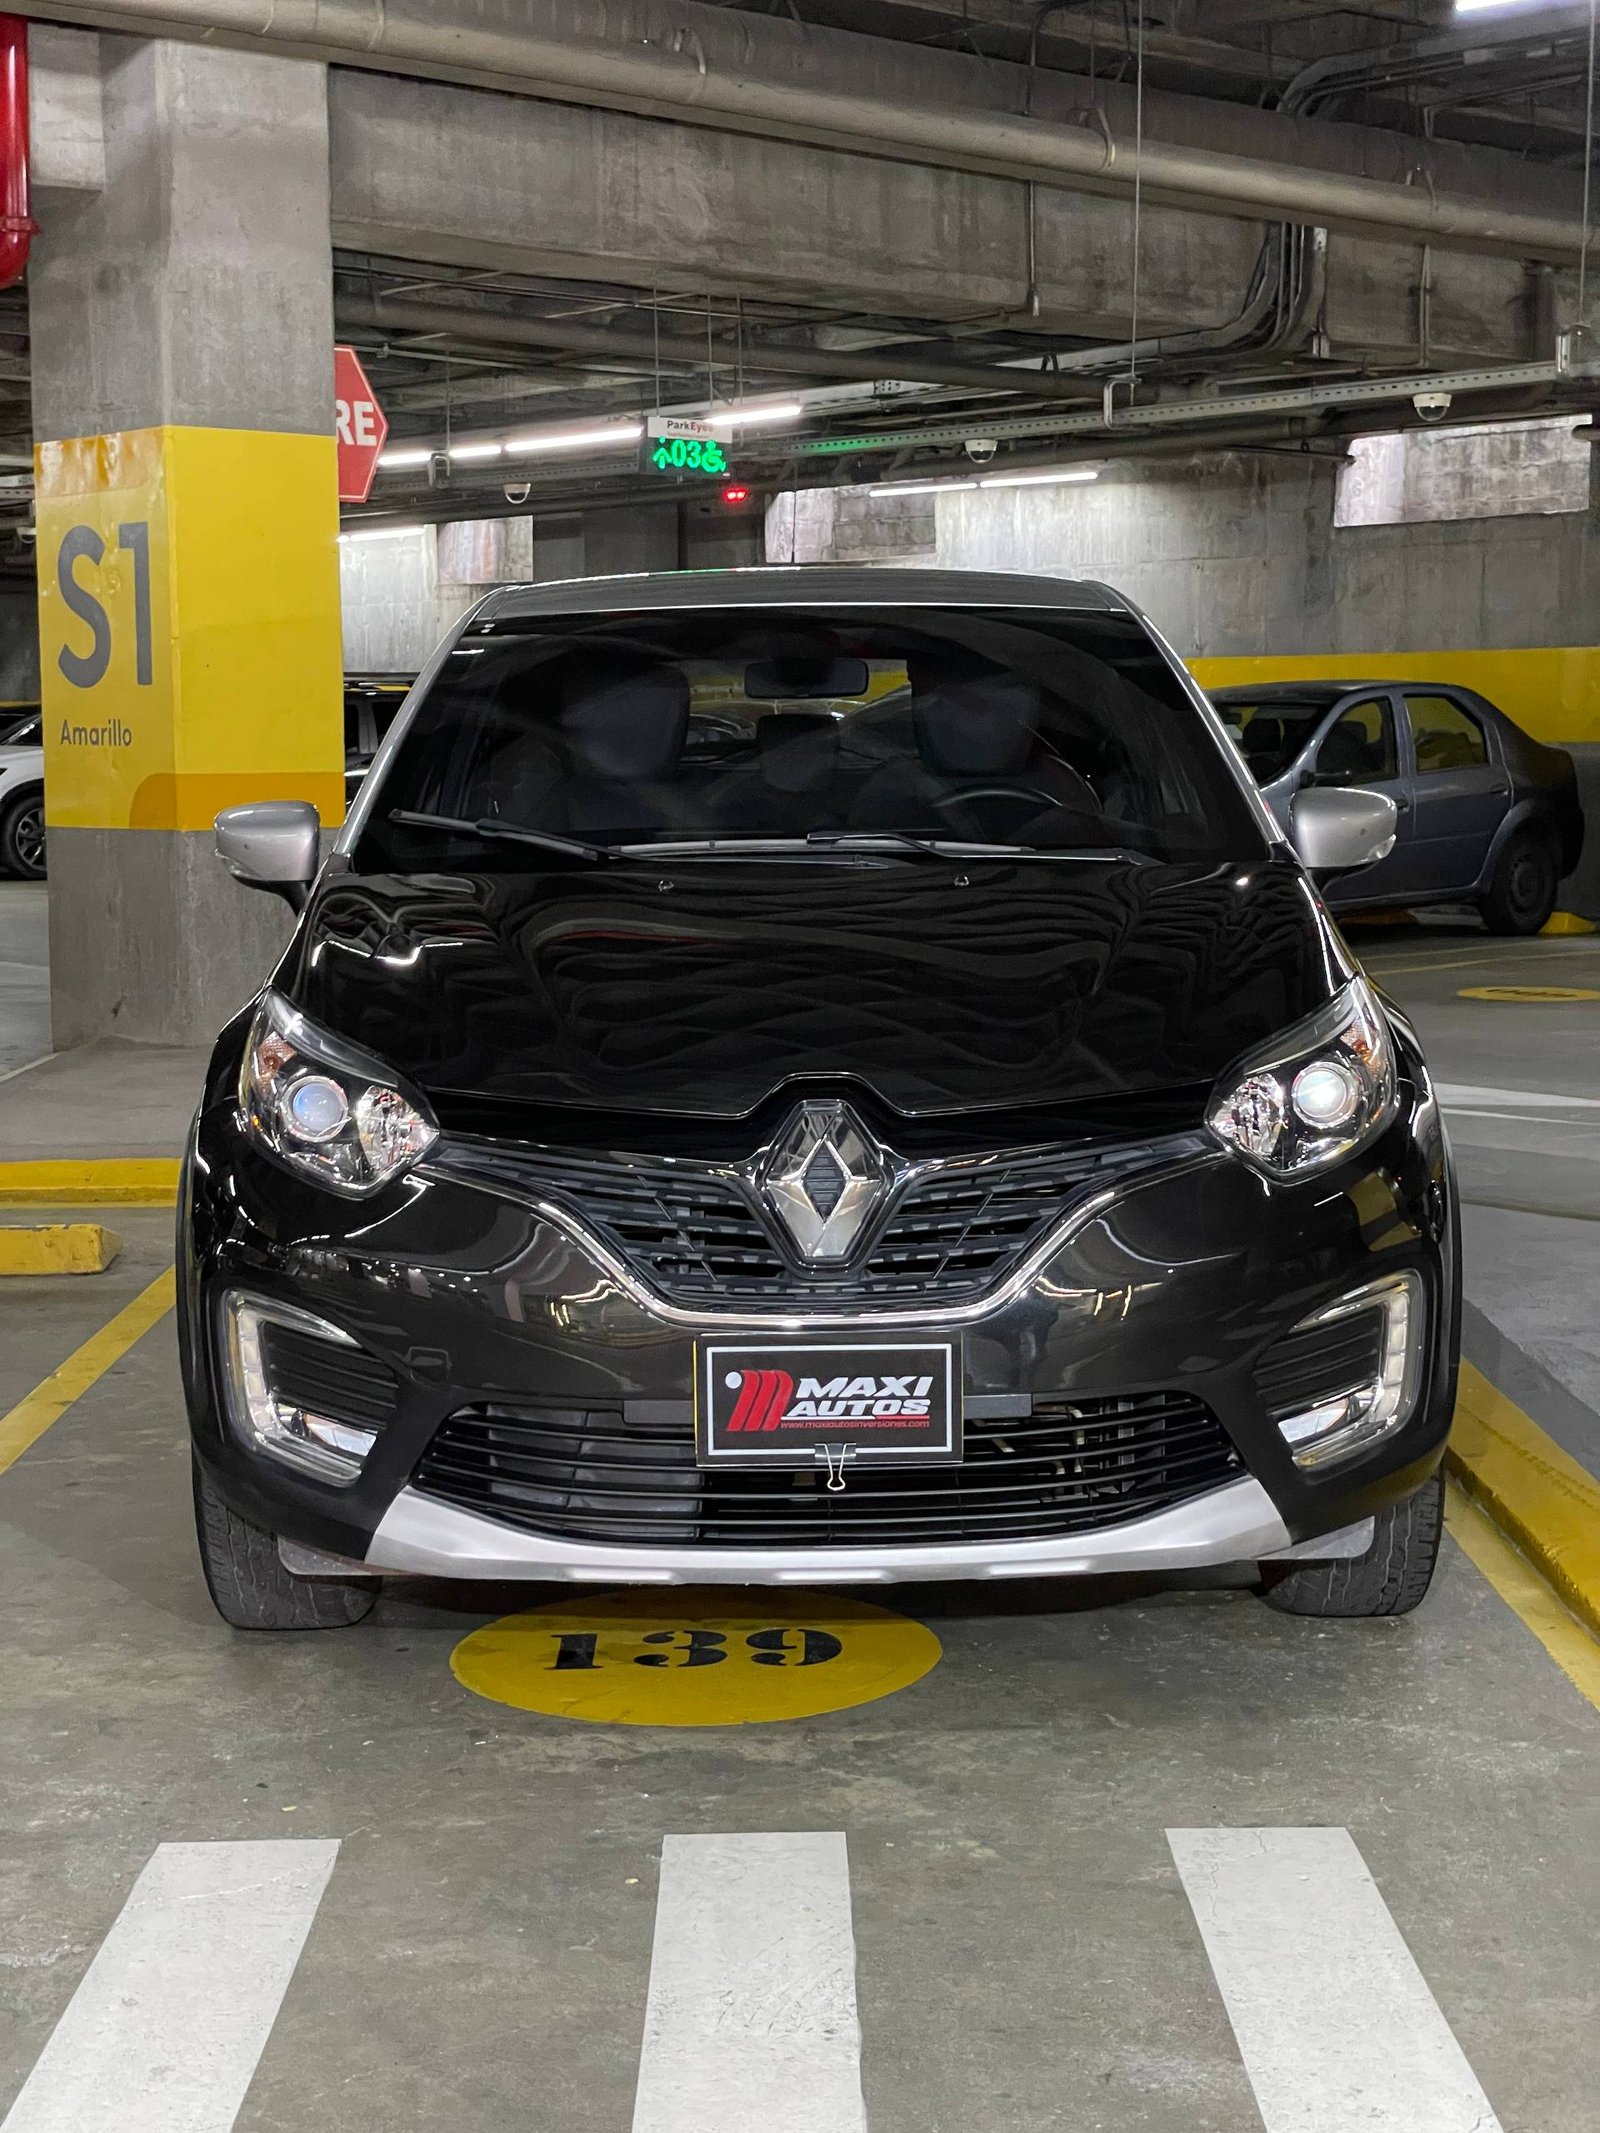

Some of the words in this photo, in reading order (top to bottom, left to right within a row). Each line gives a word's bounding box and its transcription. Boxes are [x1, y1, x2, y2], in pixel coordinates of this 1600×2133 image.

[671, 439, 701, 468] 03
[57, 521, 153, 689] S1
[59, 718, 133, 748] Amarillo
[796, 1376, 934, 1399] MAXI
[786, 1399, 931, 1417] AUTOS
[780, 1419, 930, 1429] www.maxiautosinversiones.com
[544, 1628, 843, 1670] 139
